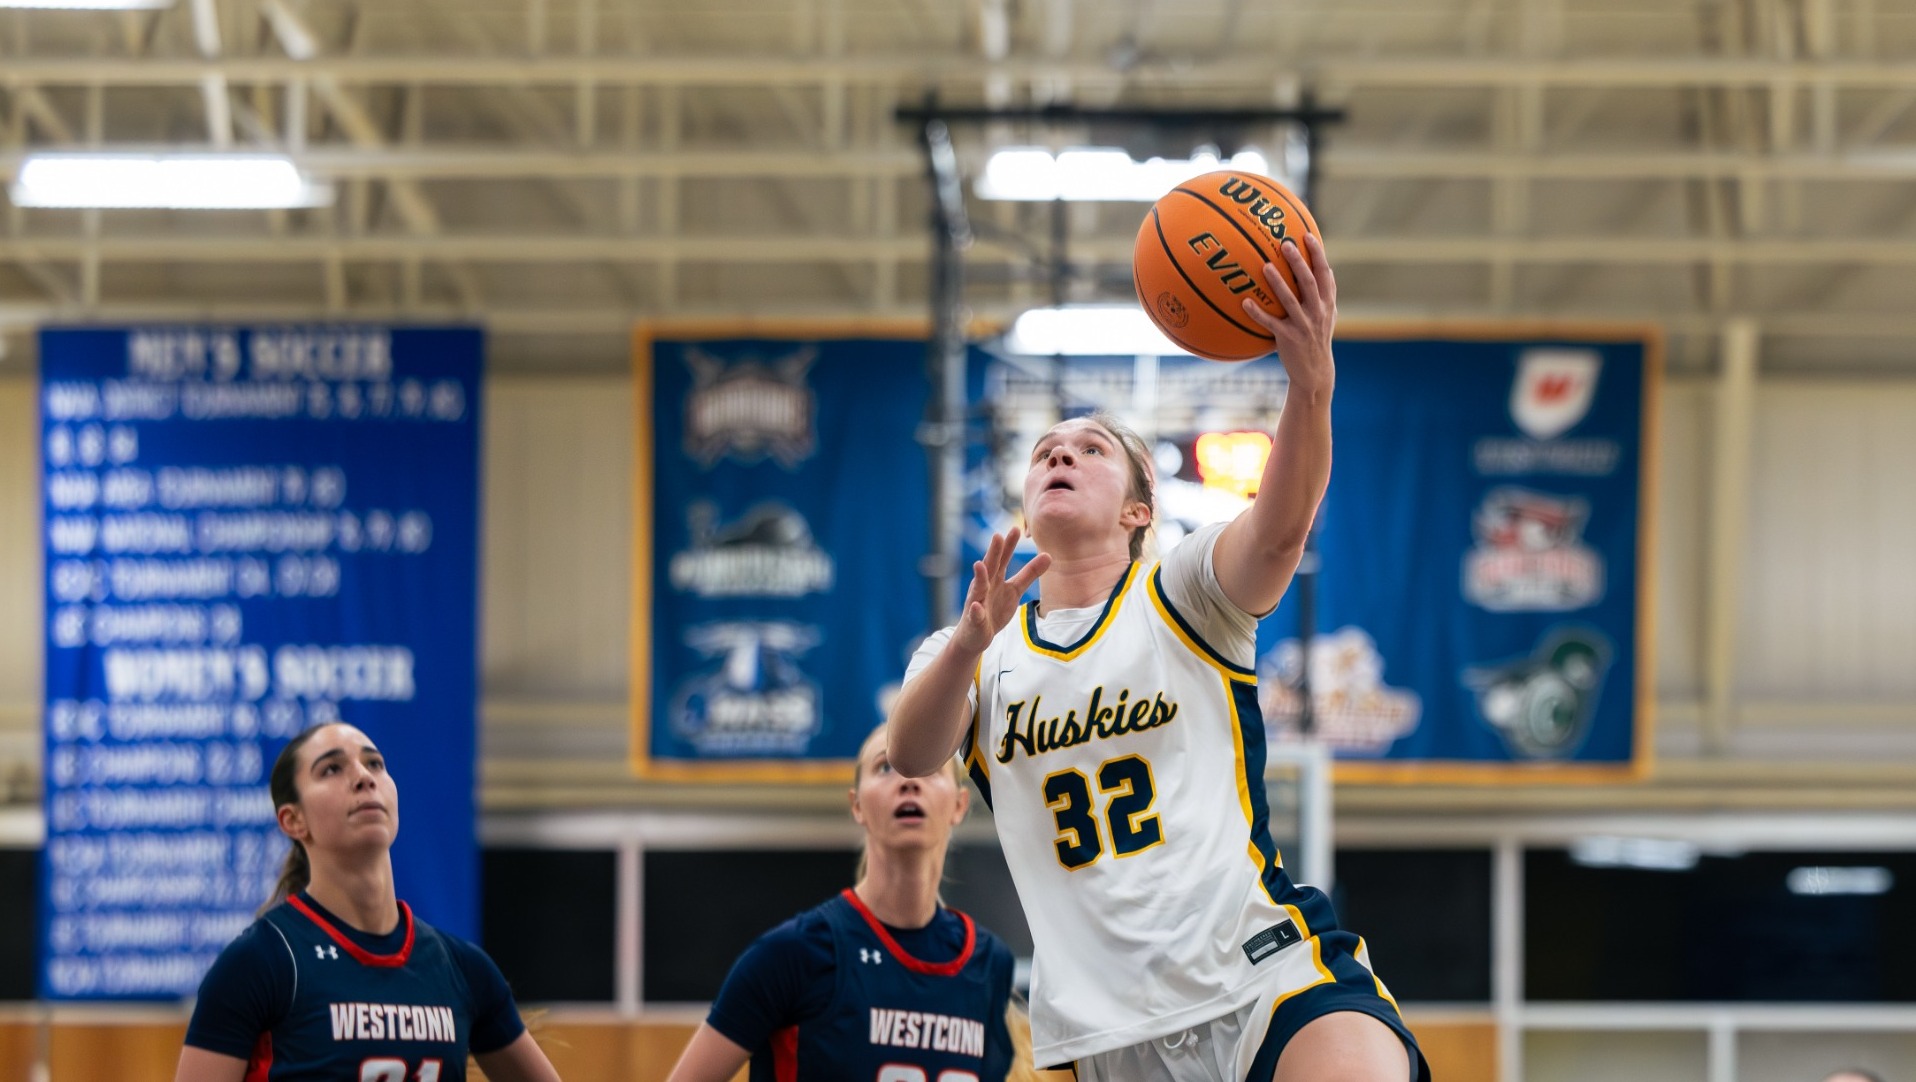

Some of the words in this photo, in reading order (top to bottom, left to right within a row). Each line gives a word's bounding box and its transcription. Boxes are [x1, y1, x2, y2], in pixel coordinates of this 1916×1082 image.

[1219, 177, 1298, 248] Wils
[1188, 231, 1257, 295] EVO
[996, 686, 1178, 764] Huskies
[1041, 753, 1166, 872] 32
[1280, 930, 1290, 939] L
[329, 1003, 456, 1042] WESTCONN
[870, 1007, 985, 1058] WESTCONN
